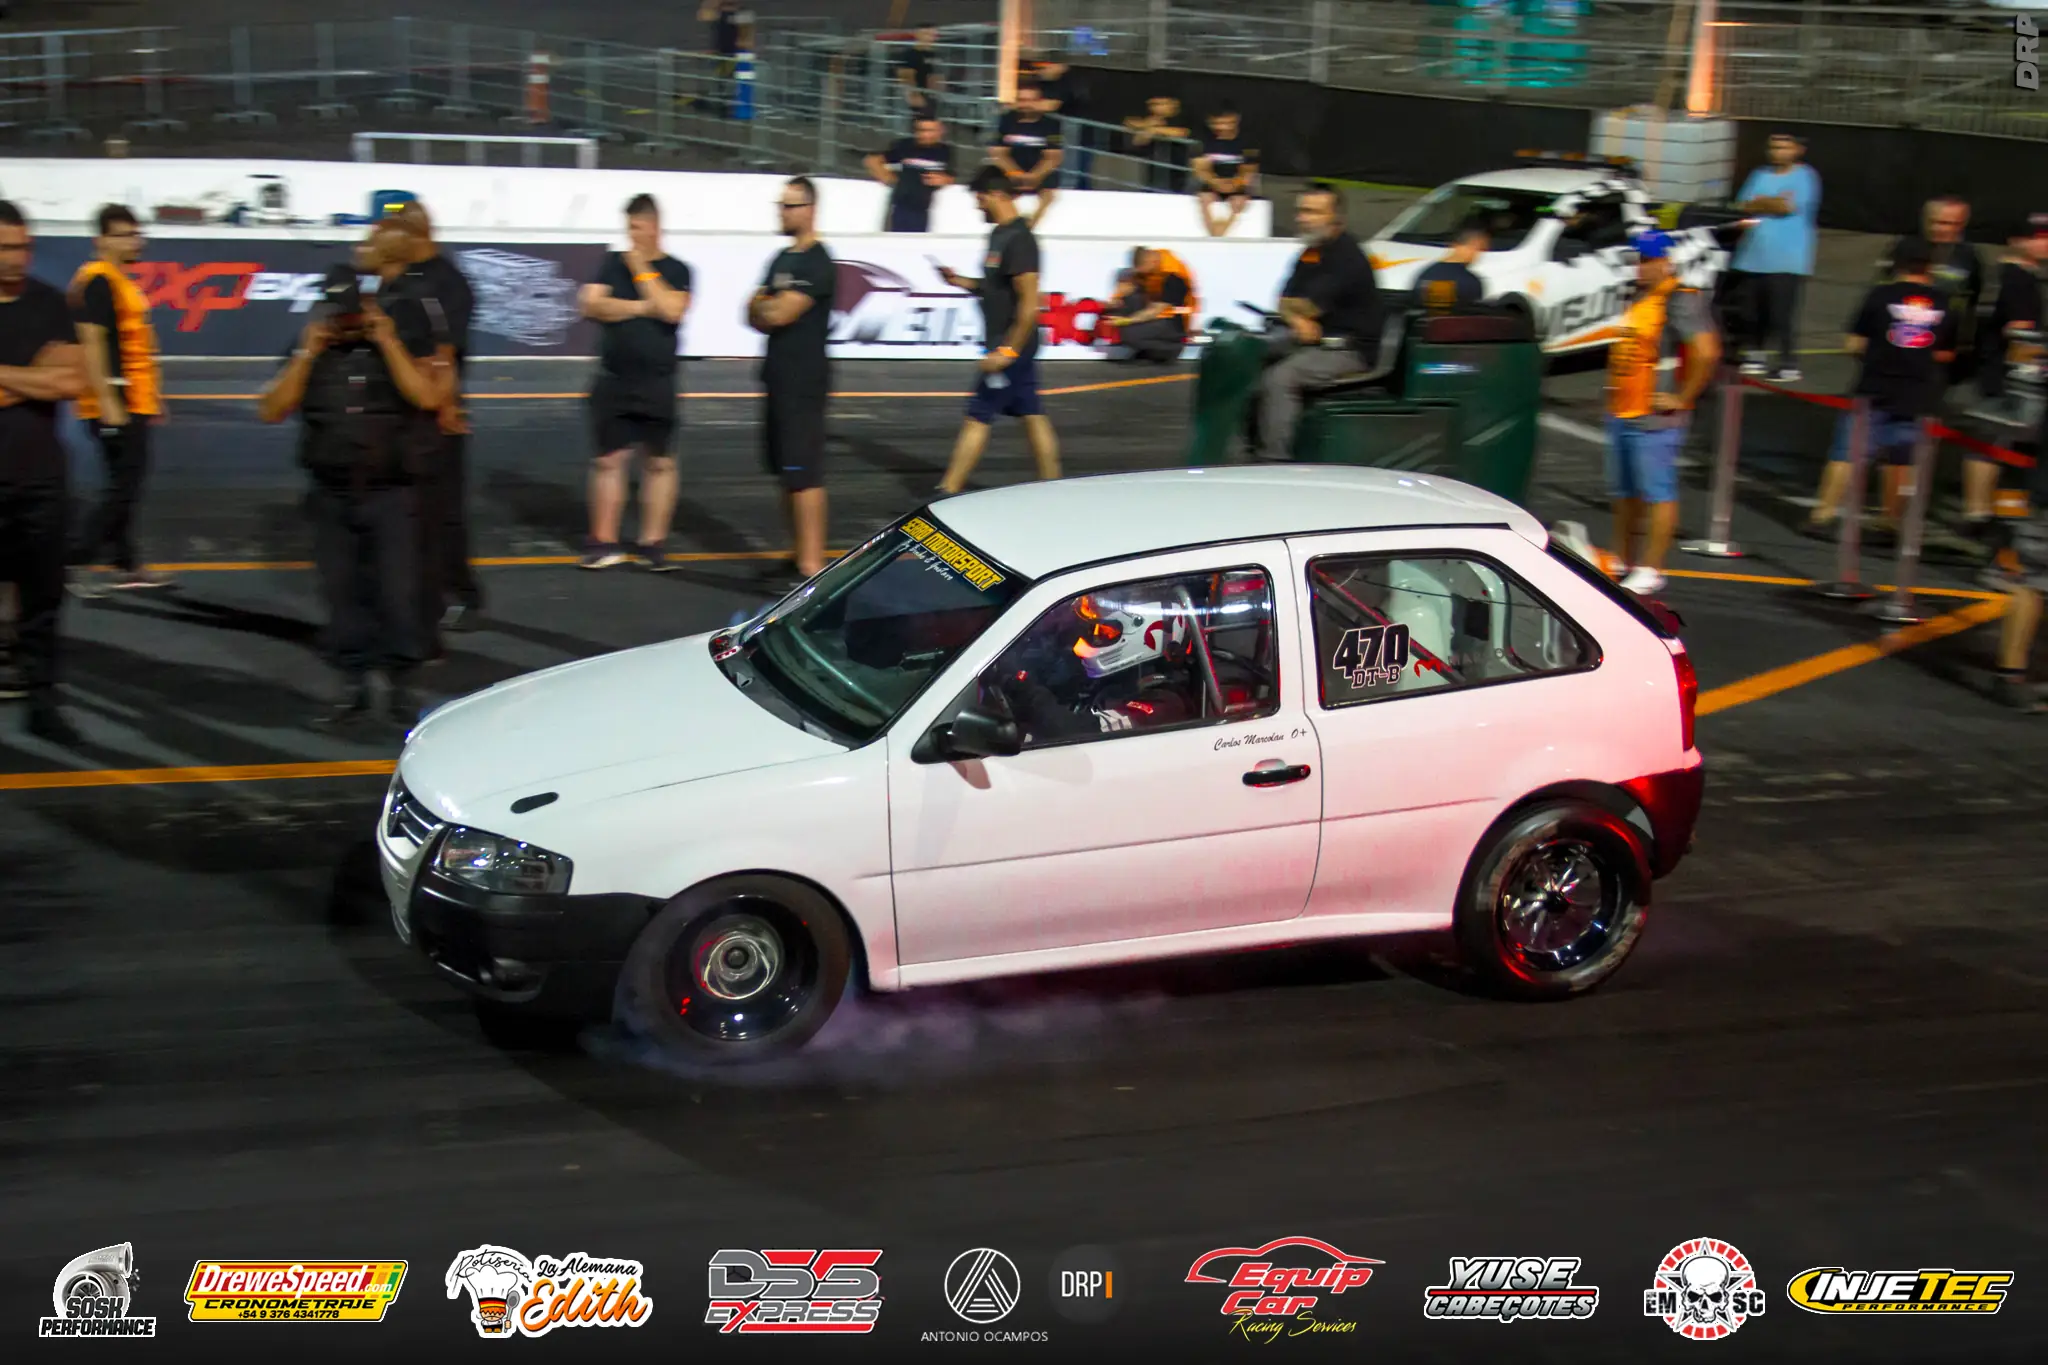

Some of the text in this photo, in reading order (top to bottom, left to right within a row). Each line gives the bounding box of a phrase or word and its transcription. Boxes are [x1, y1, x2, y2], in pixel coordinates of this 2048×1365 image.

[921, 529, 1005, 592] MOTORSPORT
[1333, 624, 1410, 679] 470
[1351, 665, 1401, 689] DT-B
[1213, 735, 1242, 751] Carlos
[1244, 732, 1285, 746] Marcolan
